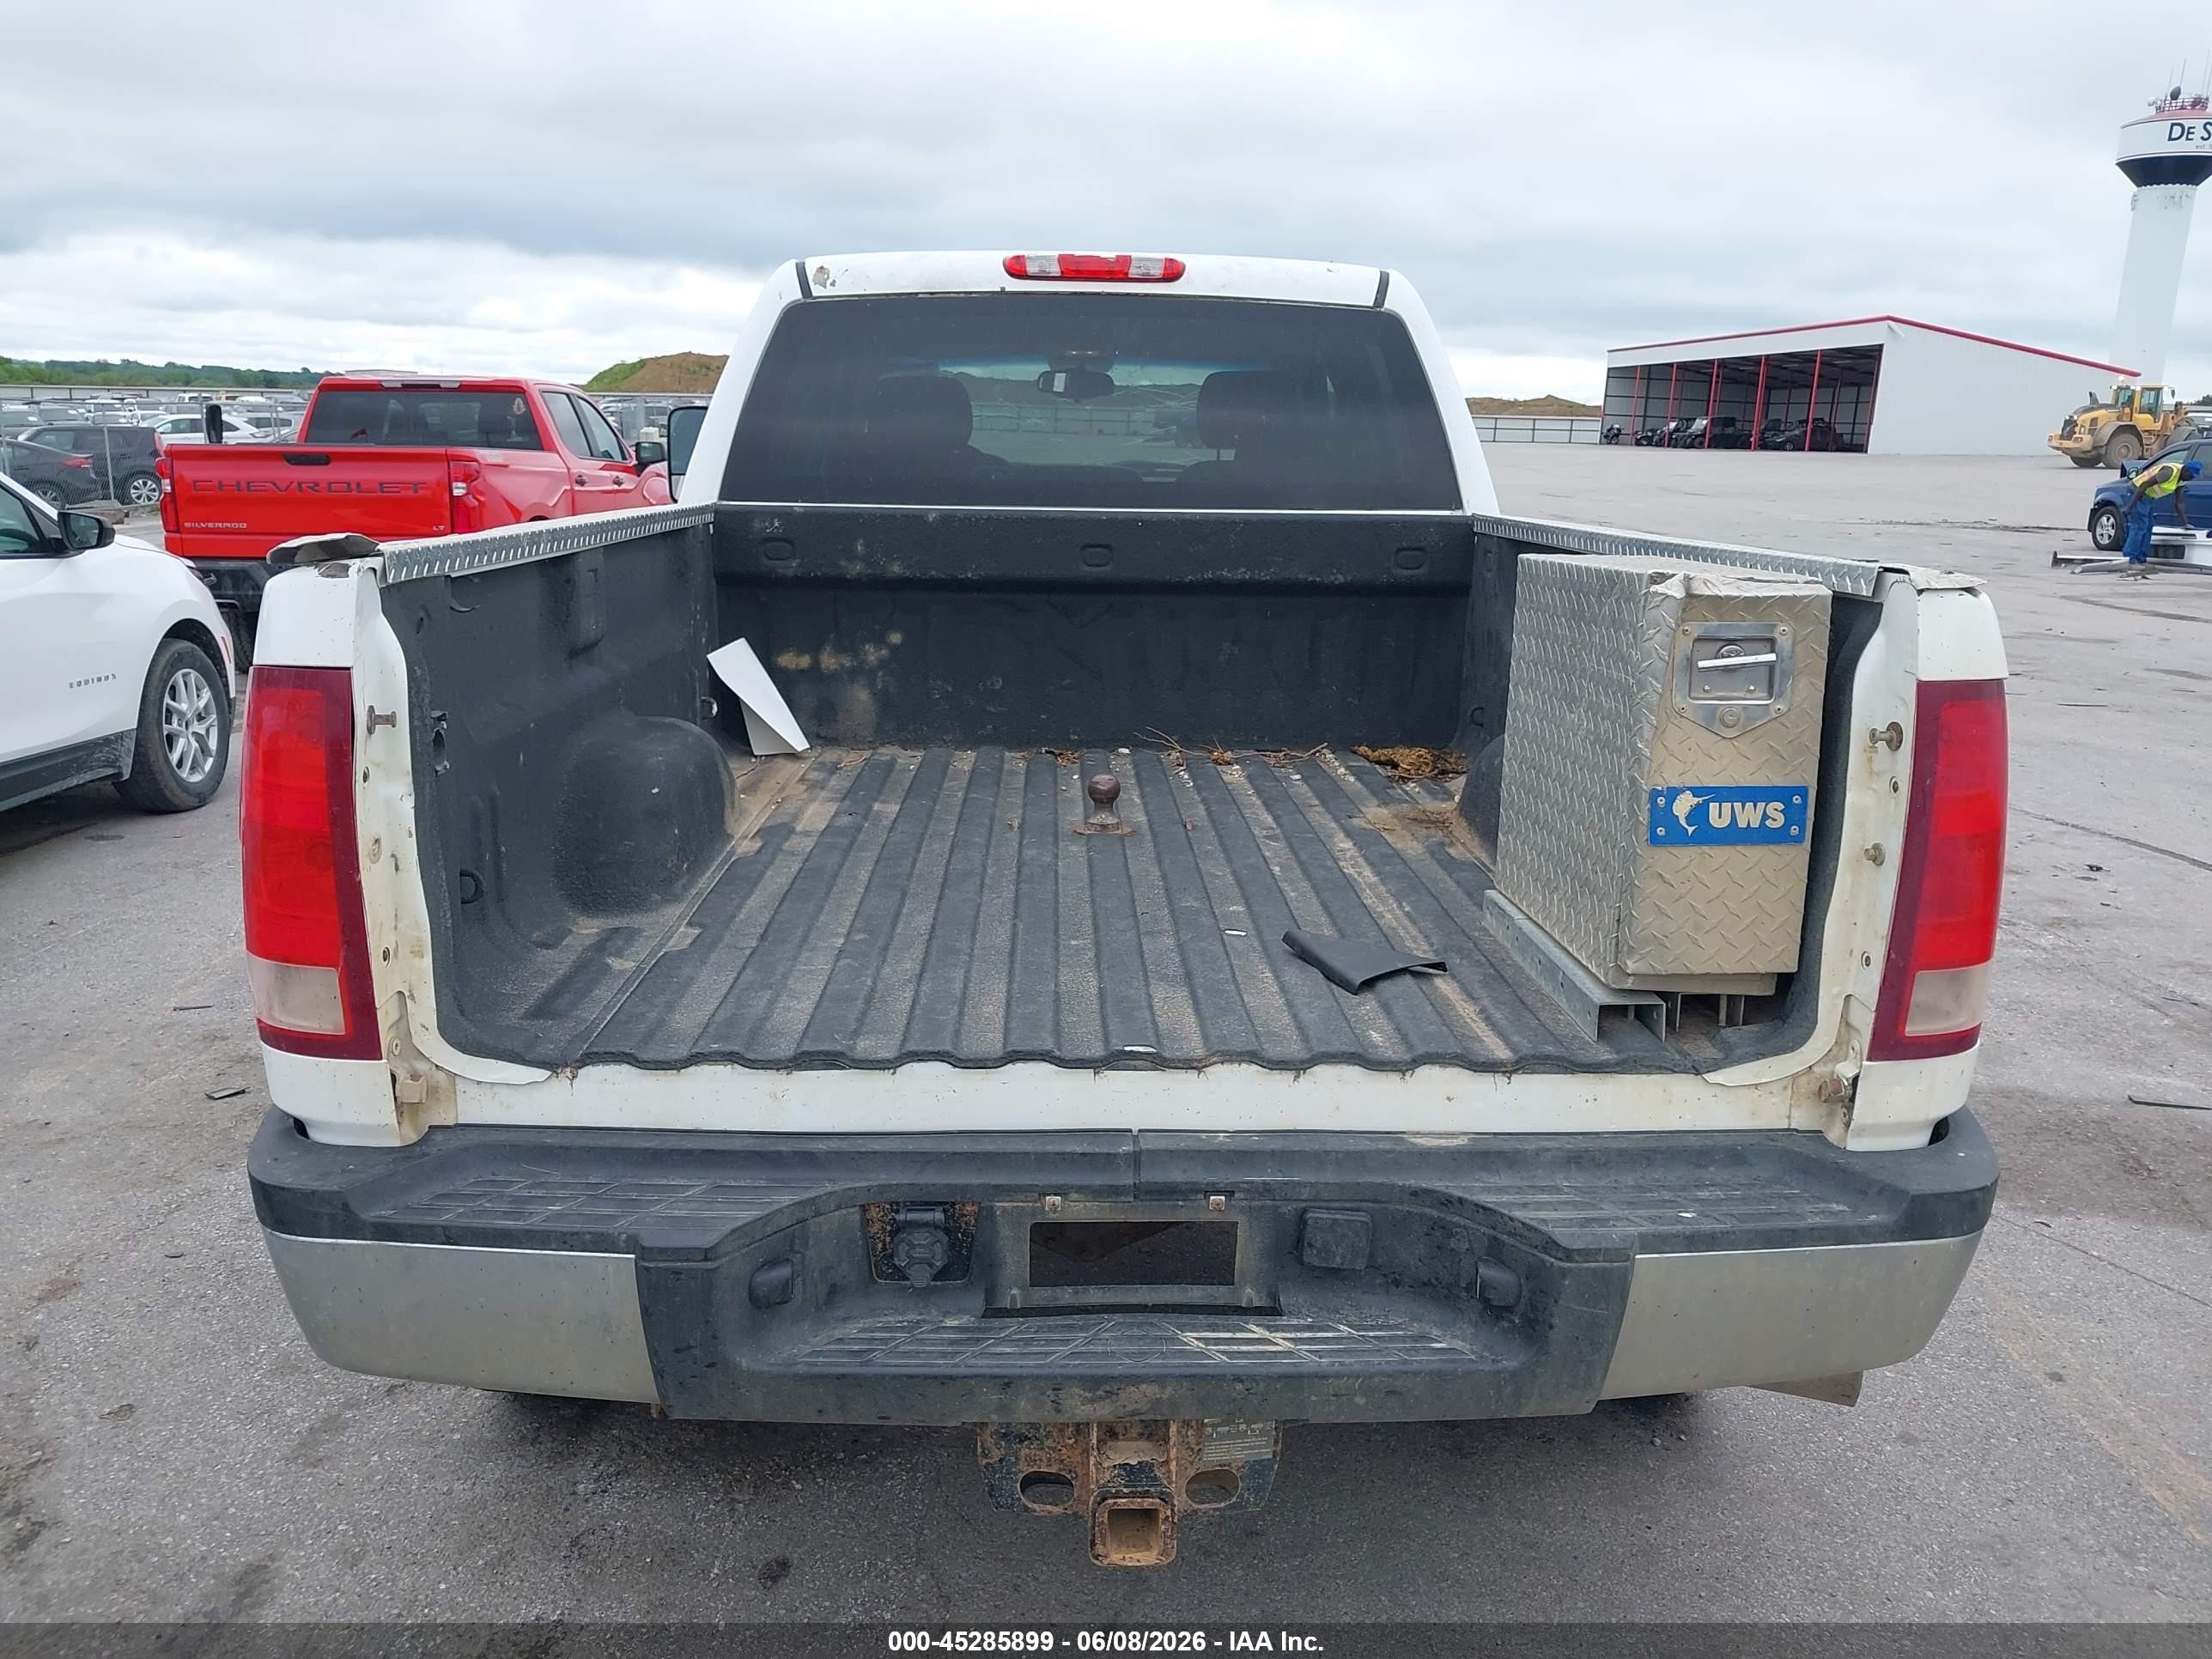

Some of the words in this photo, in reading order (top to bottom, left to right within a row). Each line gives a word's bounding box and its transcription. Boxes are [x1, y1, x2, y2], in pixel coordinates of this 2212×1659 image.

[191, 480, 427, 494] CHEVROLET
[69, 672, 117, 689] EQUINOX
[1709, 801, 1786, 829] UWS
